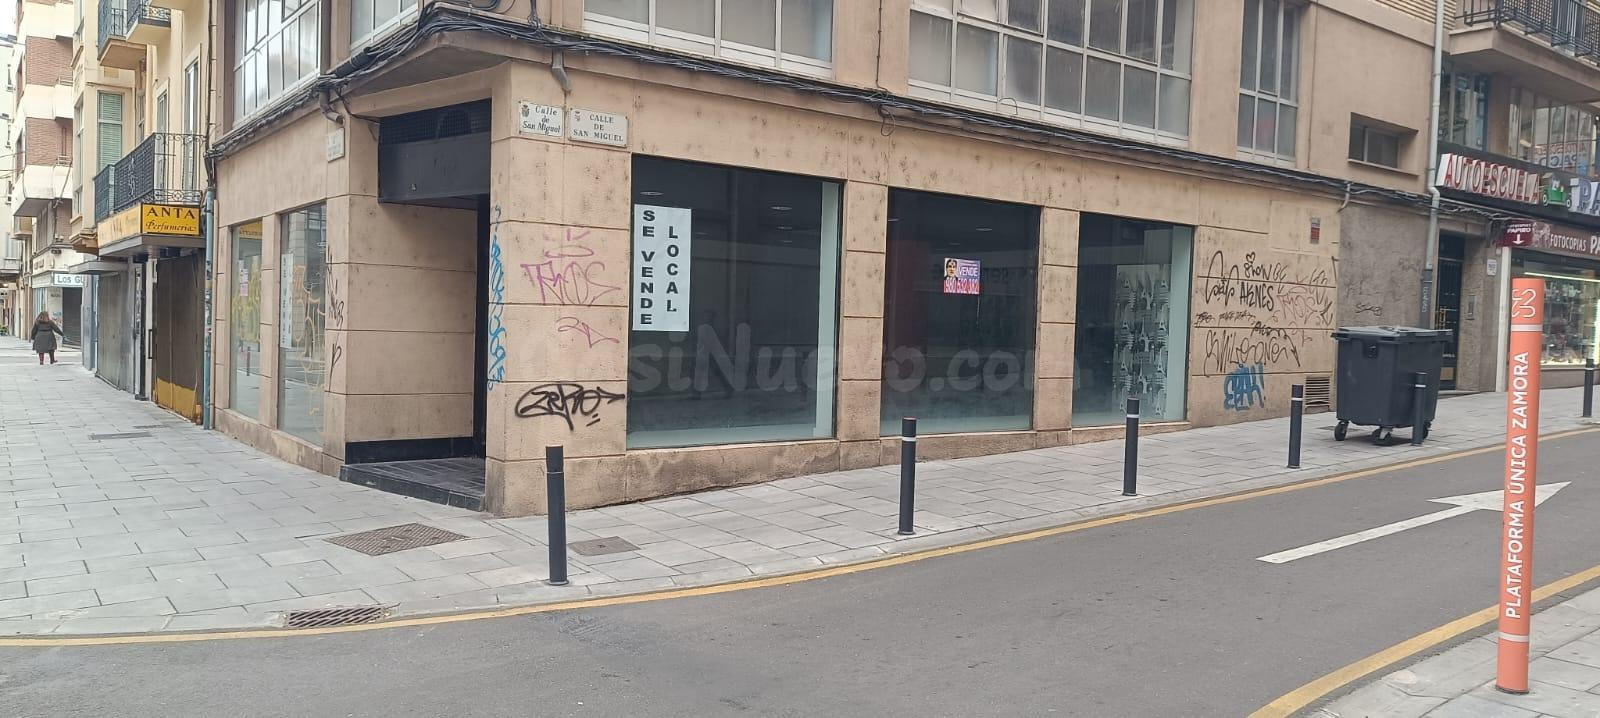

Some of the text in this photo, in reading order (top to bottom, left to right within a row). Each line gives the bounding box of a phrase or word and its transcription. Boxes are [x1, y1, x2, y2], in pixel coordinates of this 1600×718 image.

[535, 105, 558, 116] Calle
[589, 114, 614, 124] CALLE
[522, 121, 561, 135] San Miguel
[593, 123, 604, 131] DE
[573, 129, 624, 142] SAN MIGUEL
[1441, 153, 1540, 204] AUTOESCUELA
[147, 207, 196, 219] ANTA
[1550, 233, 1587, 252] FOTOCOPIAS
[640, 210, 656, 325] SE VENDE
[666, 226, 680, 312] LOCAL
[958, 266, 979, 277] VENDE
[57, 275, 72, 284] Los
[1505, 351, 1529, 618] PLATAFORMA ÚNICA ZAMORA
